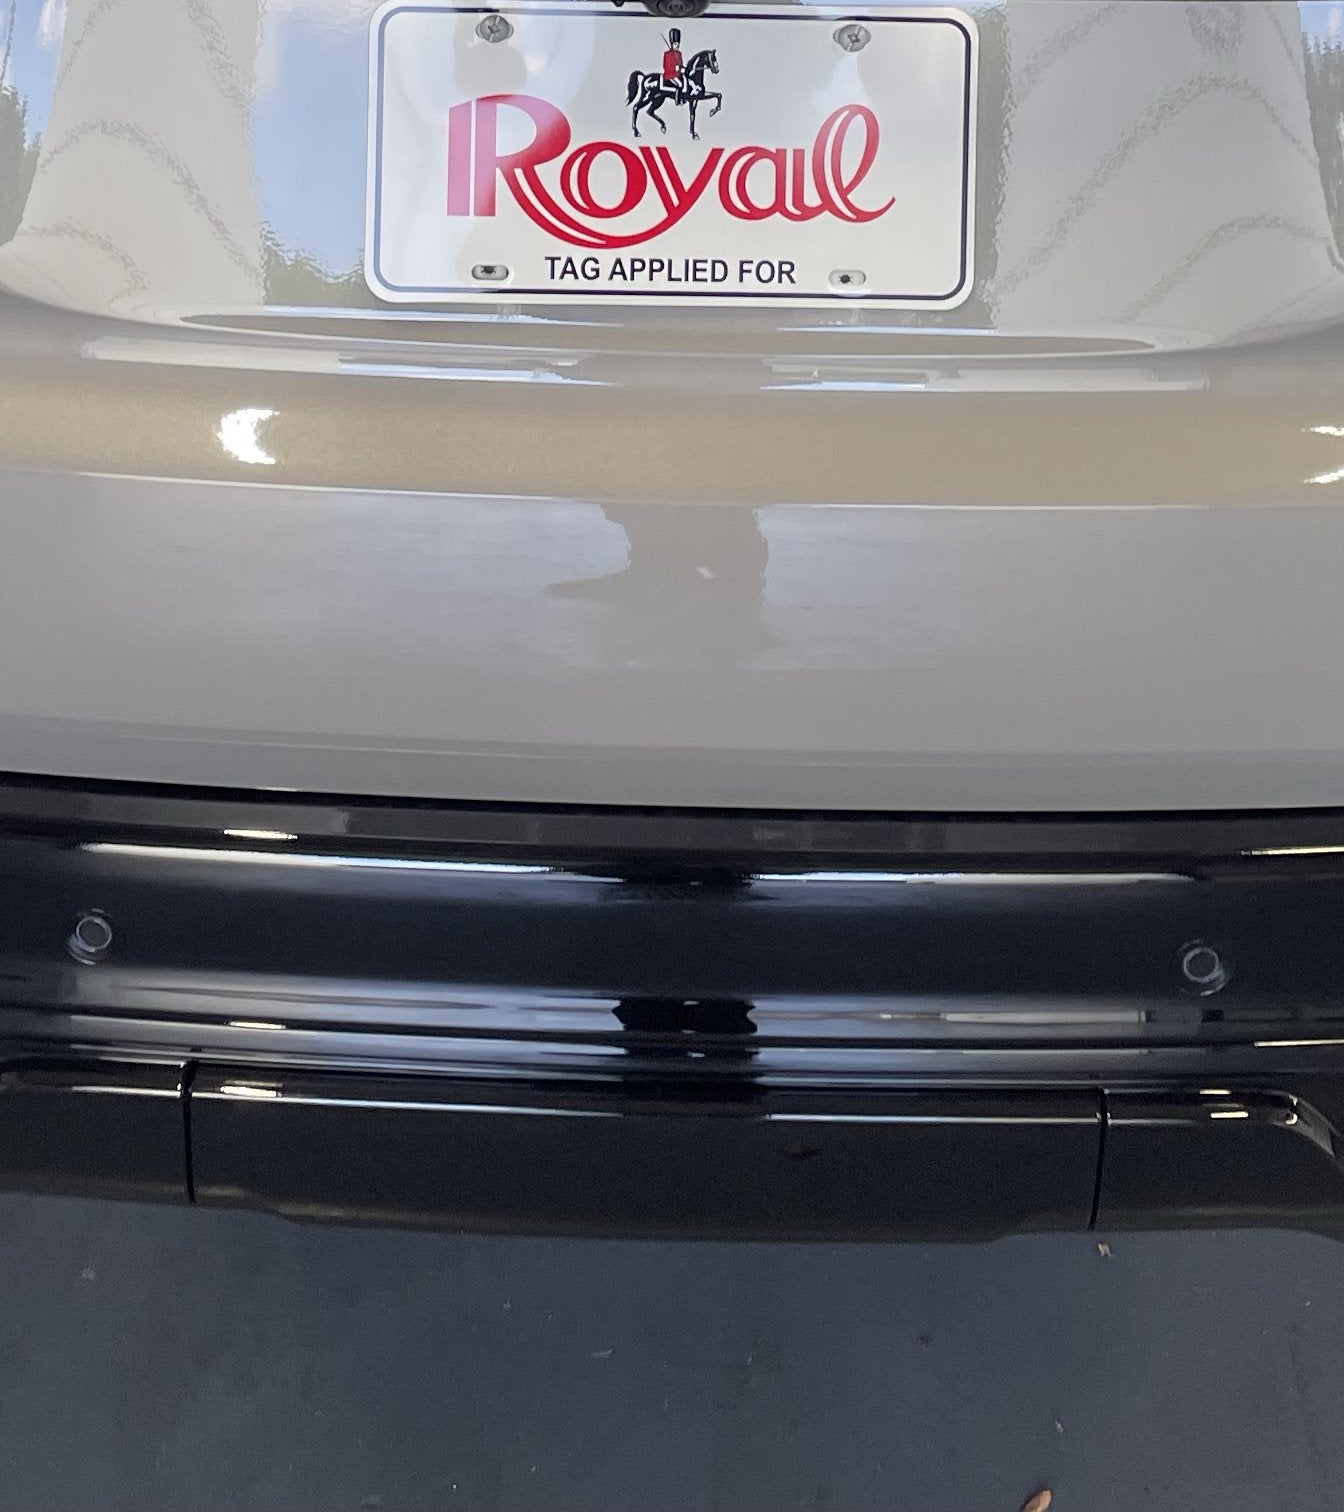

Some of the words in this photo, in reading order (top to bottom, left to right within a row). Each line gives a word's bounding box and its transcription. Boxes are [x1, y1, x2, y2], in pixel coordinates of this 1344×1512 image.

[446, 92, 897, 250] Royal
[544, 255, 601, 282] TAG
[607, 257, 730, 284] APPLIED
[737, 259, 797, 285] FOR
